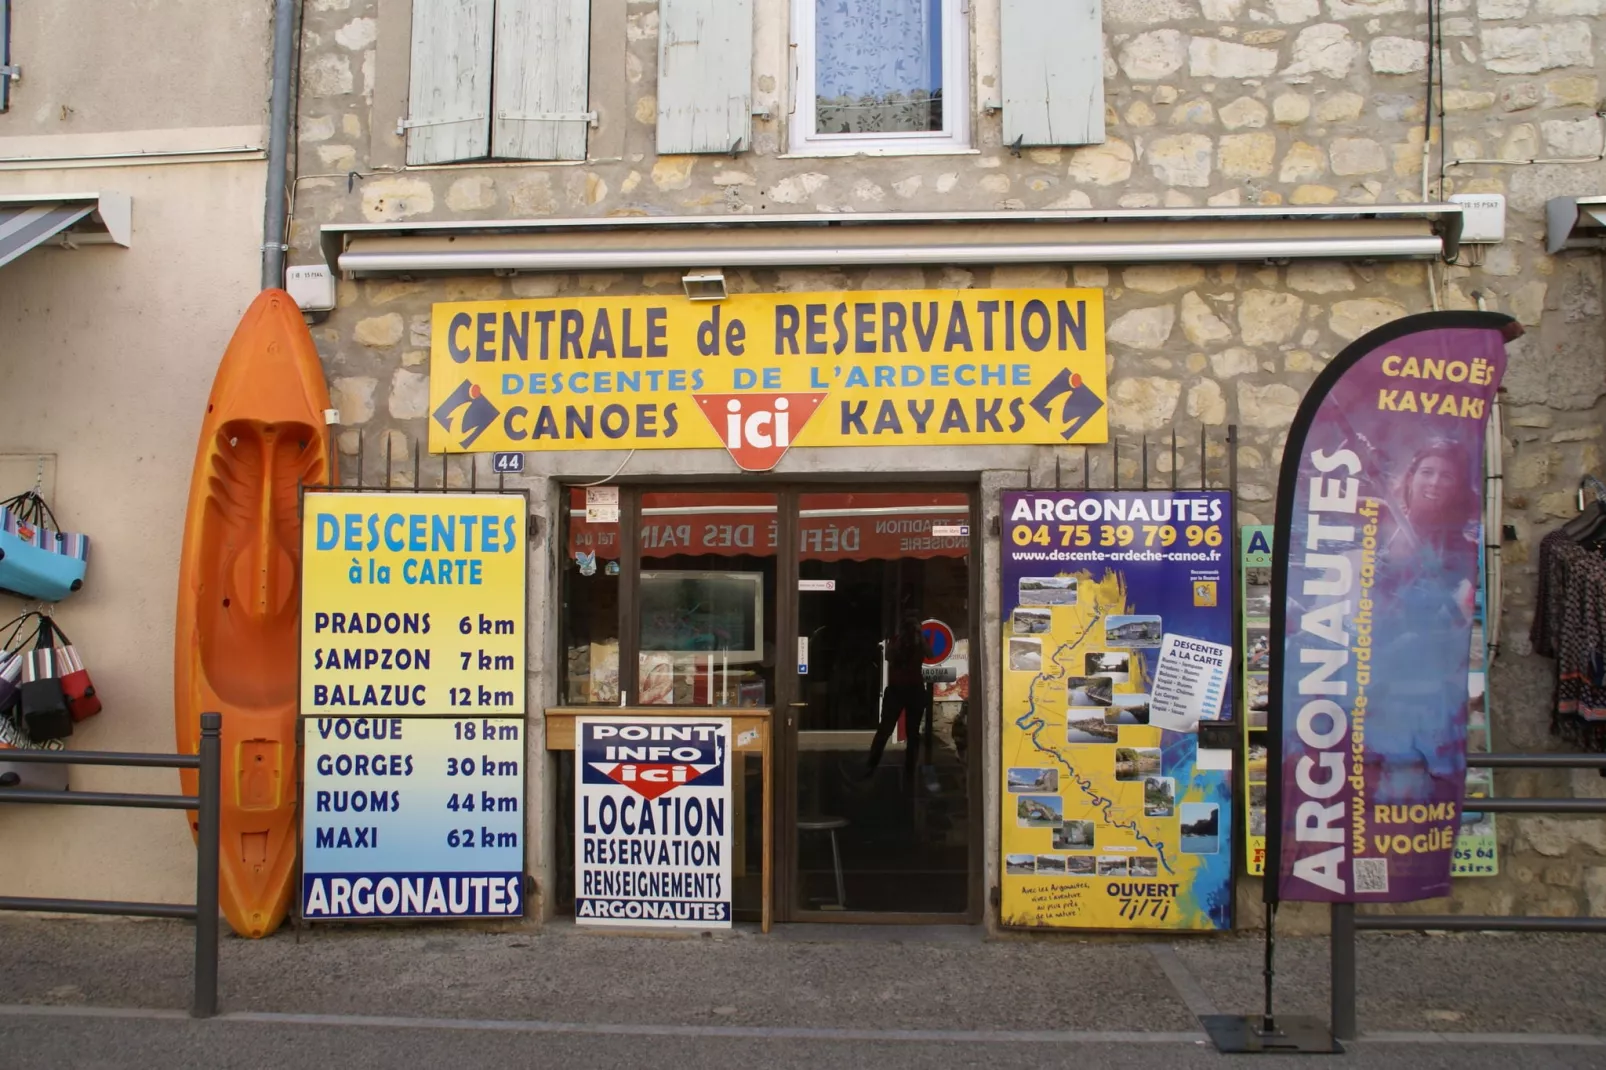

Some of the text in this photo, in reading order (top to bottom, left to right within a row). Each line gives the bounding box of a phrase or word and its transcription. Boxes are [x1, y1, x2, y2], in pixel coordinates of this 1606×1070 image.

[448, 299, 1087, 363] CENTRALE de RESERVATION
[502, 364, 1031, 395] DESCENTES DE L'ARDECHE
[503, 397, 1025, 441] CANOES KAYAKS
[727, 398, 789, 449] ici
[498, 455, 519, 469] 44
[1011, 499, 1223, 521] ARGONAUTES
[316, 513, 516, 553] DESCENTES
[1012, 525, 1223, 547] 04 75 39 79 96
[1012, 549, 1222, 562] www.descente-ardeche-canoe.fr
[349, 557, 482, 585] à la CARTE
[315, 612, 515, 634] PRADONS 6 km
[1173, 639, 1223, 656] DESCENTES
[314, 648, 514, 670] SAMPZON 7 km
[1179, 651, 1191, 660] LA
[1193, 654, 1223, 667] CARTE
[1293, 448, 1362, 895] ARGONAUTES
[1349, 496, 1380, 855] www.descente-ardeche-canoe.fr
[313, 684, 514, 706] BALAZUC 12 km
[317, 718, 519, 740] VOGUE 18 km
[593, 726, 717, 741] POINT
[606, 746, 702, 761] INFO
[316, 754, 518, 776] GORGES 30 km
[622, 765, 687, 782] ici
[316, 790, 518, 812] RUOMS 44 km
[583, 795, 725, 836] LOCATION
[1374, 802, 1456, 824] RUOMS
[316, 827, 517, 848] MAXI 62 km
[584, 838, 720, 866] RESERVATION
[1476, 847, 1493, 859] 64
[306, 876, 519, 914] ARGONAUTES
[584, 870, 722, 898] RENSEIGNEMENTS
[1106, 883, 1179, 897] OUVERT
[579, 900, 726, 920] ARGONAUTES
[1119, 899, 1171, 921] 7j/7j
